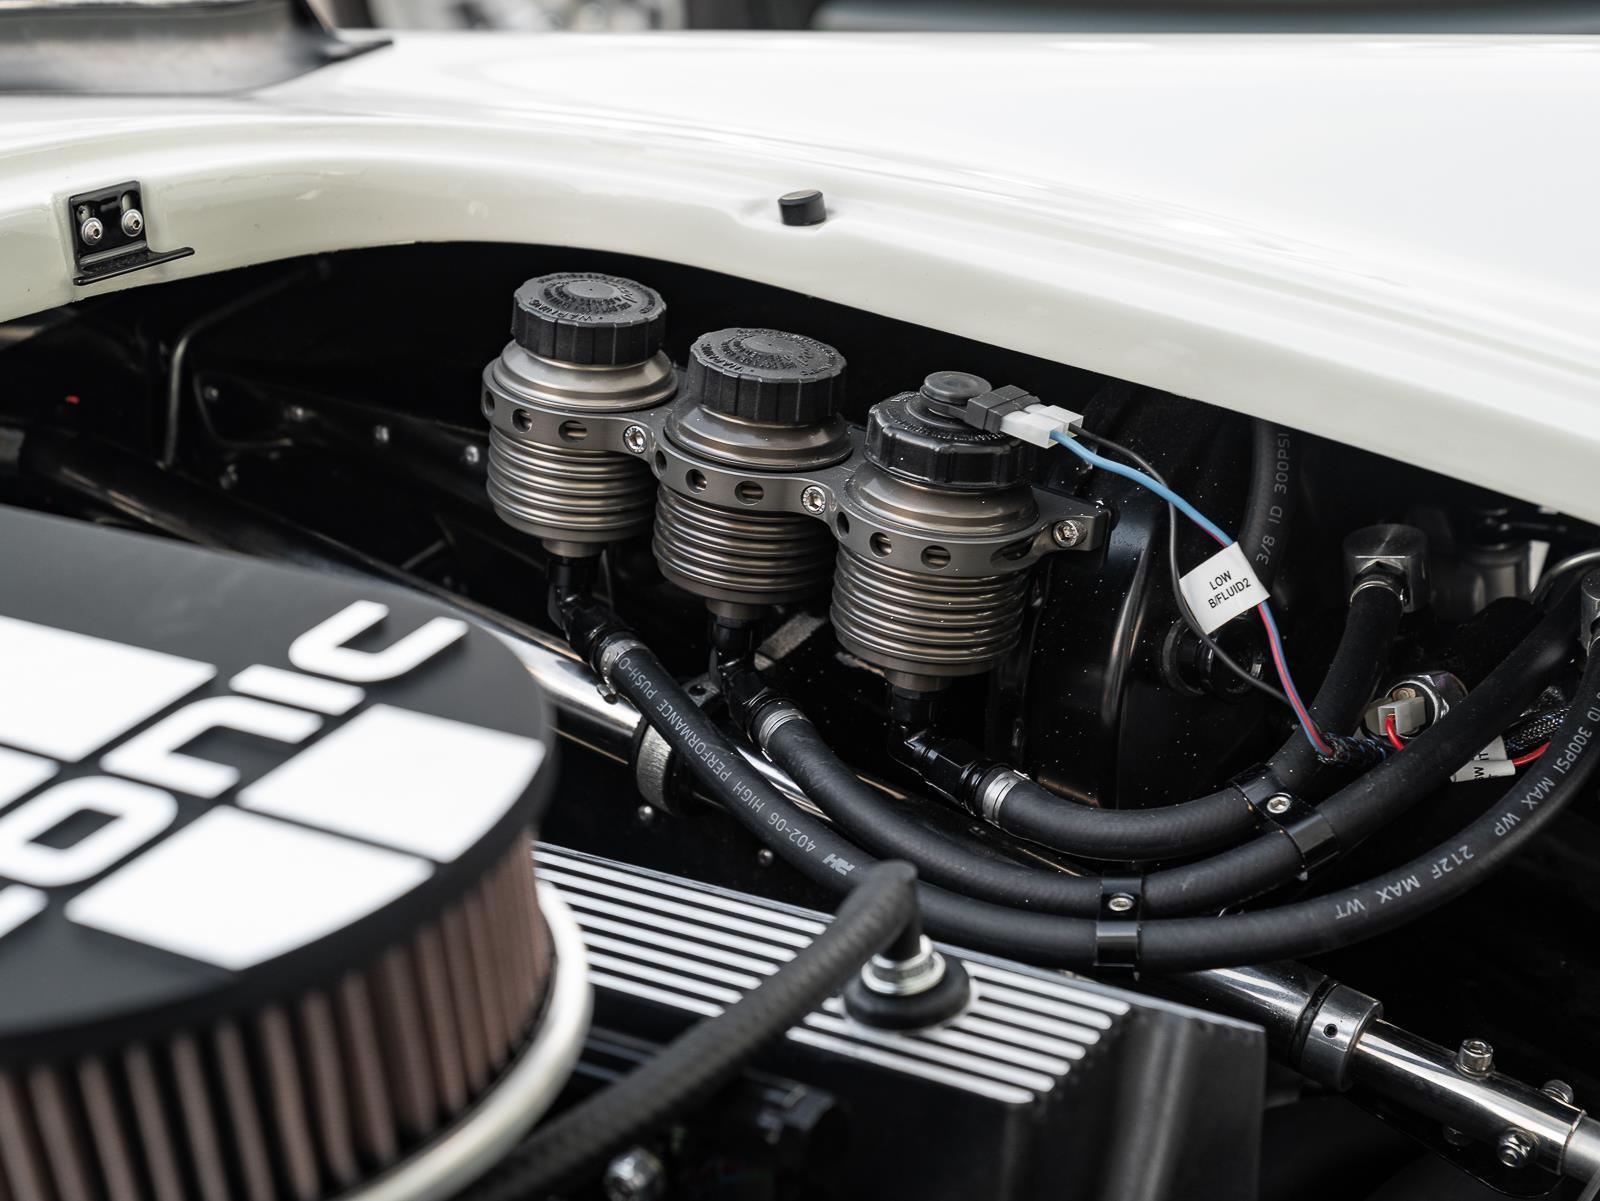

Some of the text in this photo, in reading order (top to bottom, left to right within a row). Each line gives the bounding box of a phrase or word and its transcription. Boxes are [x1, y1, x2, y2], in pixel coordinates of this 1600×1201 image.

[1256, 433, 1290, 565] 3/8 ID 300PSI
[1208, 577, 1251, 609] B/FLUID2
[1209, 570, 1232, 590] LOW
[615, 656, 659, 700] PUSH-O
[656, 698, 731, 782] PERFORMANCE
[1558, 726, 1592, 775] 300PSI
[0, 600, 469, 938] onic
[732, 779, 765, 812] HIGH
[1521, 776, 1556, 810] MAX
[767, 811, 816, 853] 402-06
[1495, 812, 1521, 837] WP
[1432, 844, 1474, 879] 212F
[1376, 875, 1421, 904] MAX
[1335, 898, 1366, 919] WT
